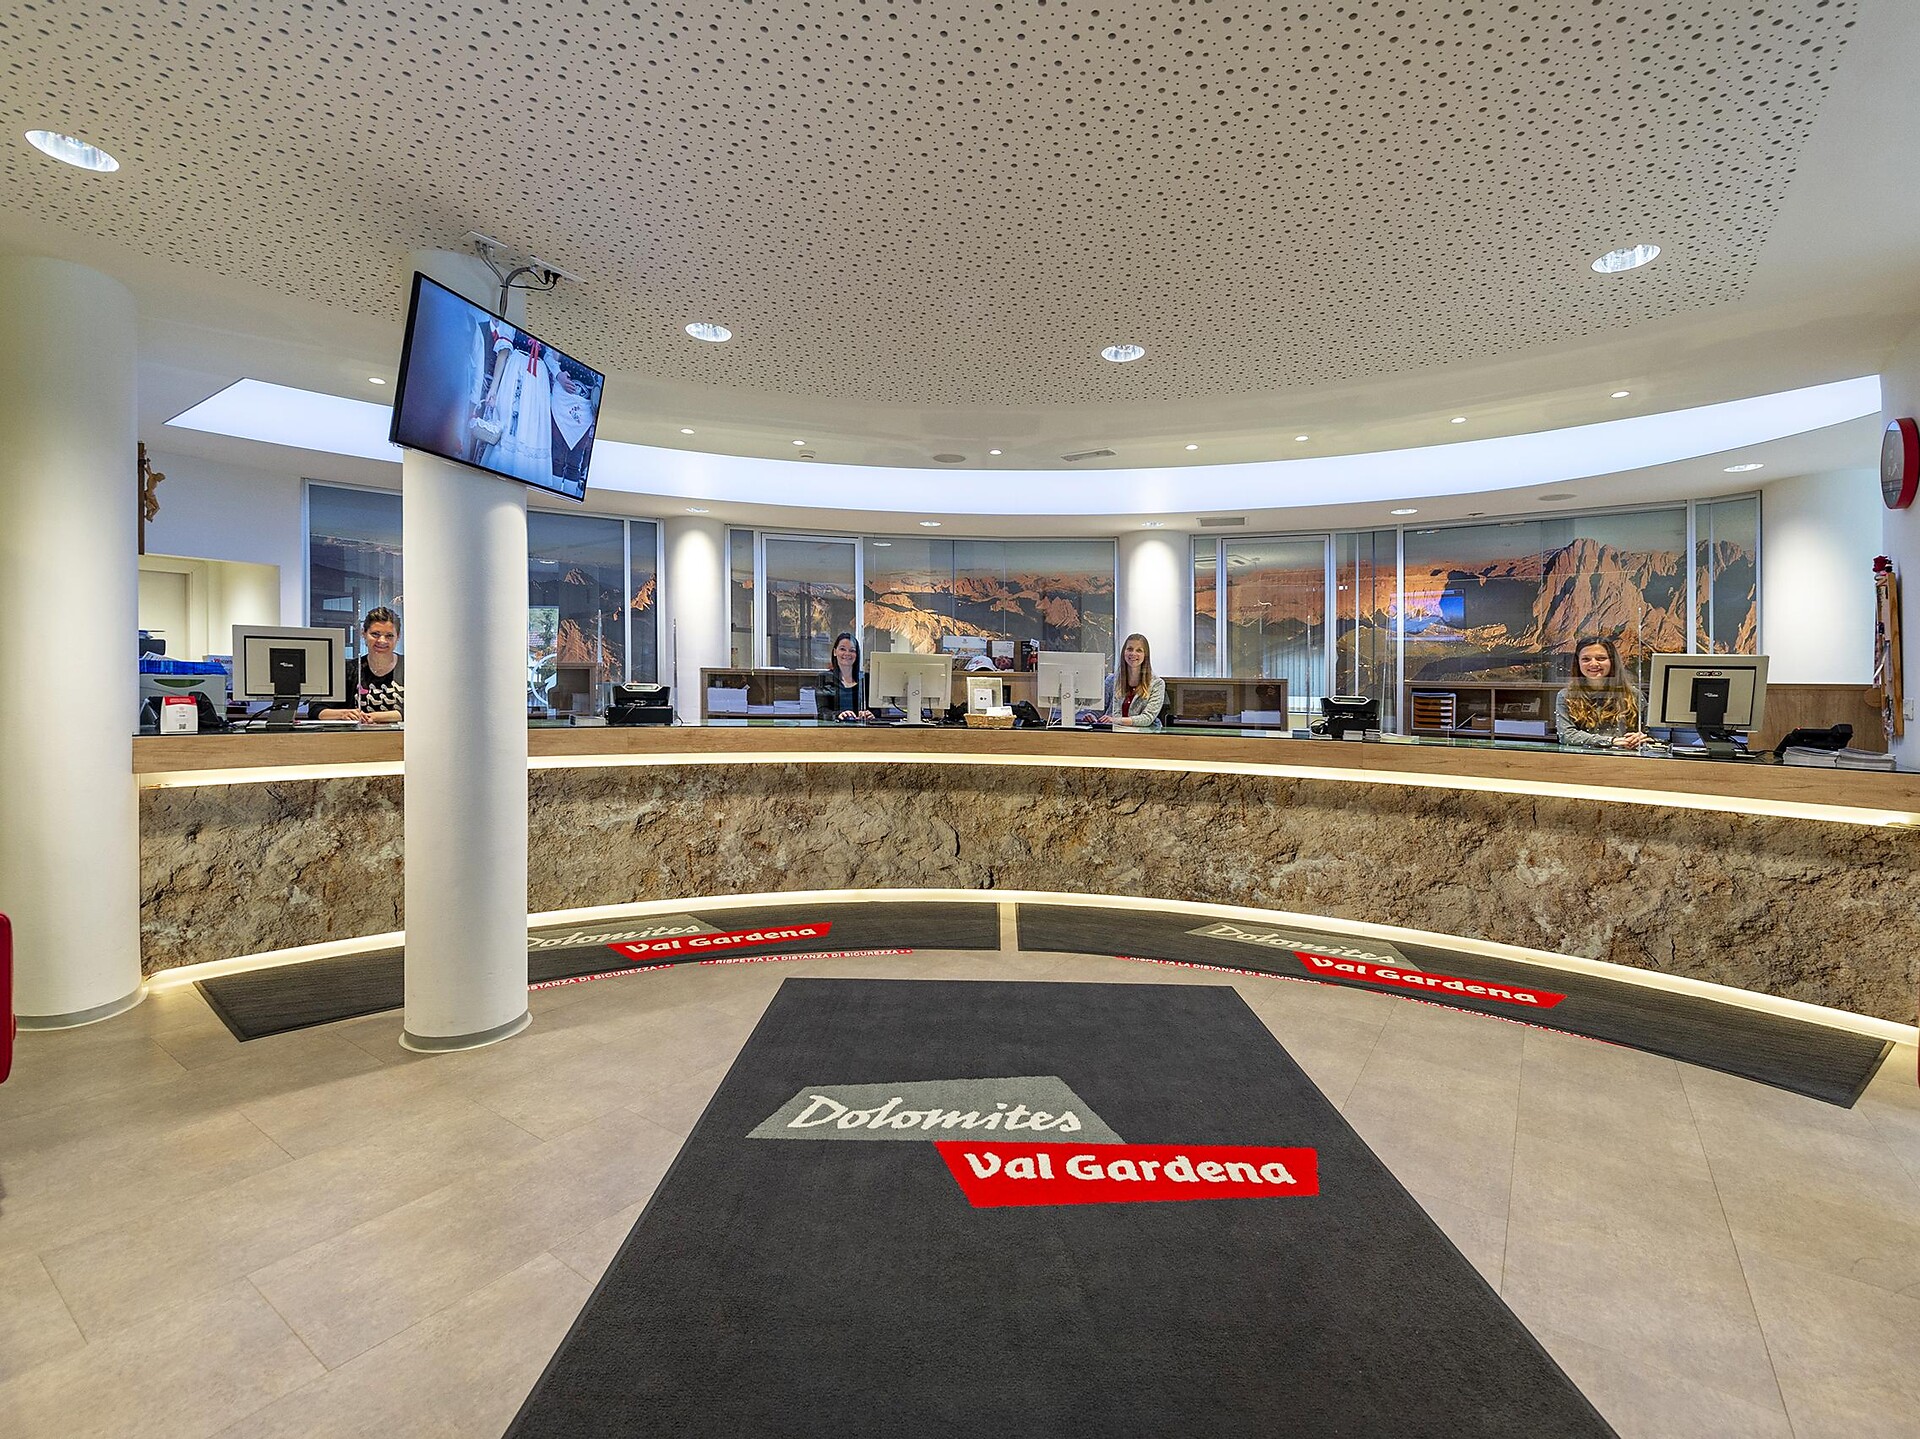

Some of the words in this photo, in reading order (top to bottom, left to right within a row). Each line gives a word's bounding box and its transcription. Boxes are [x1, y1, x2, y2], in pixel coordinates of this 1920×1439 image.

[625, 940, 681, 953] Val
[688, 927, 817, 946] Gardena
[1207, 924, 1396, 964] Dolomites
[716, 956, 764, 965] RISPETTA
[781, 953, 829, 961] DISTANZA
[527, 978, 576, 991] ISTANZA
[593, 965, 657, 980] SICUREZZA
[1309, 956, 1367, 974] Val
[1375, 969, 1538, 1003] Gardena
[787, 1094, 1082, 1133] Dolomites
[963, 1152, 1055, 1182] Val
[1065, 1155, 1297, 1185] Gardena
